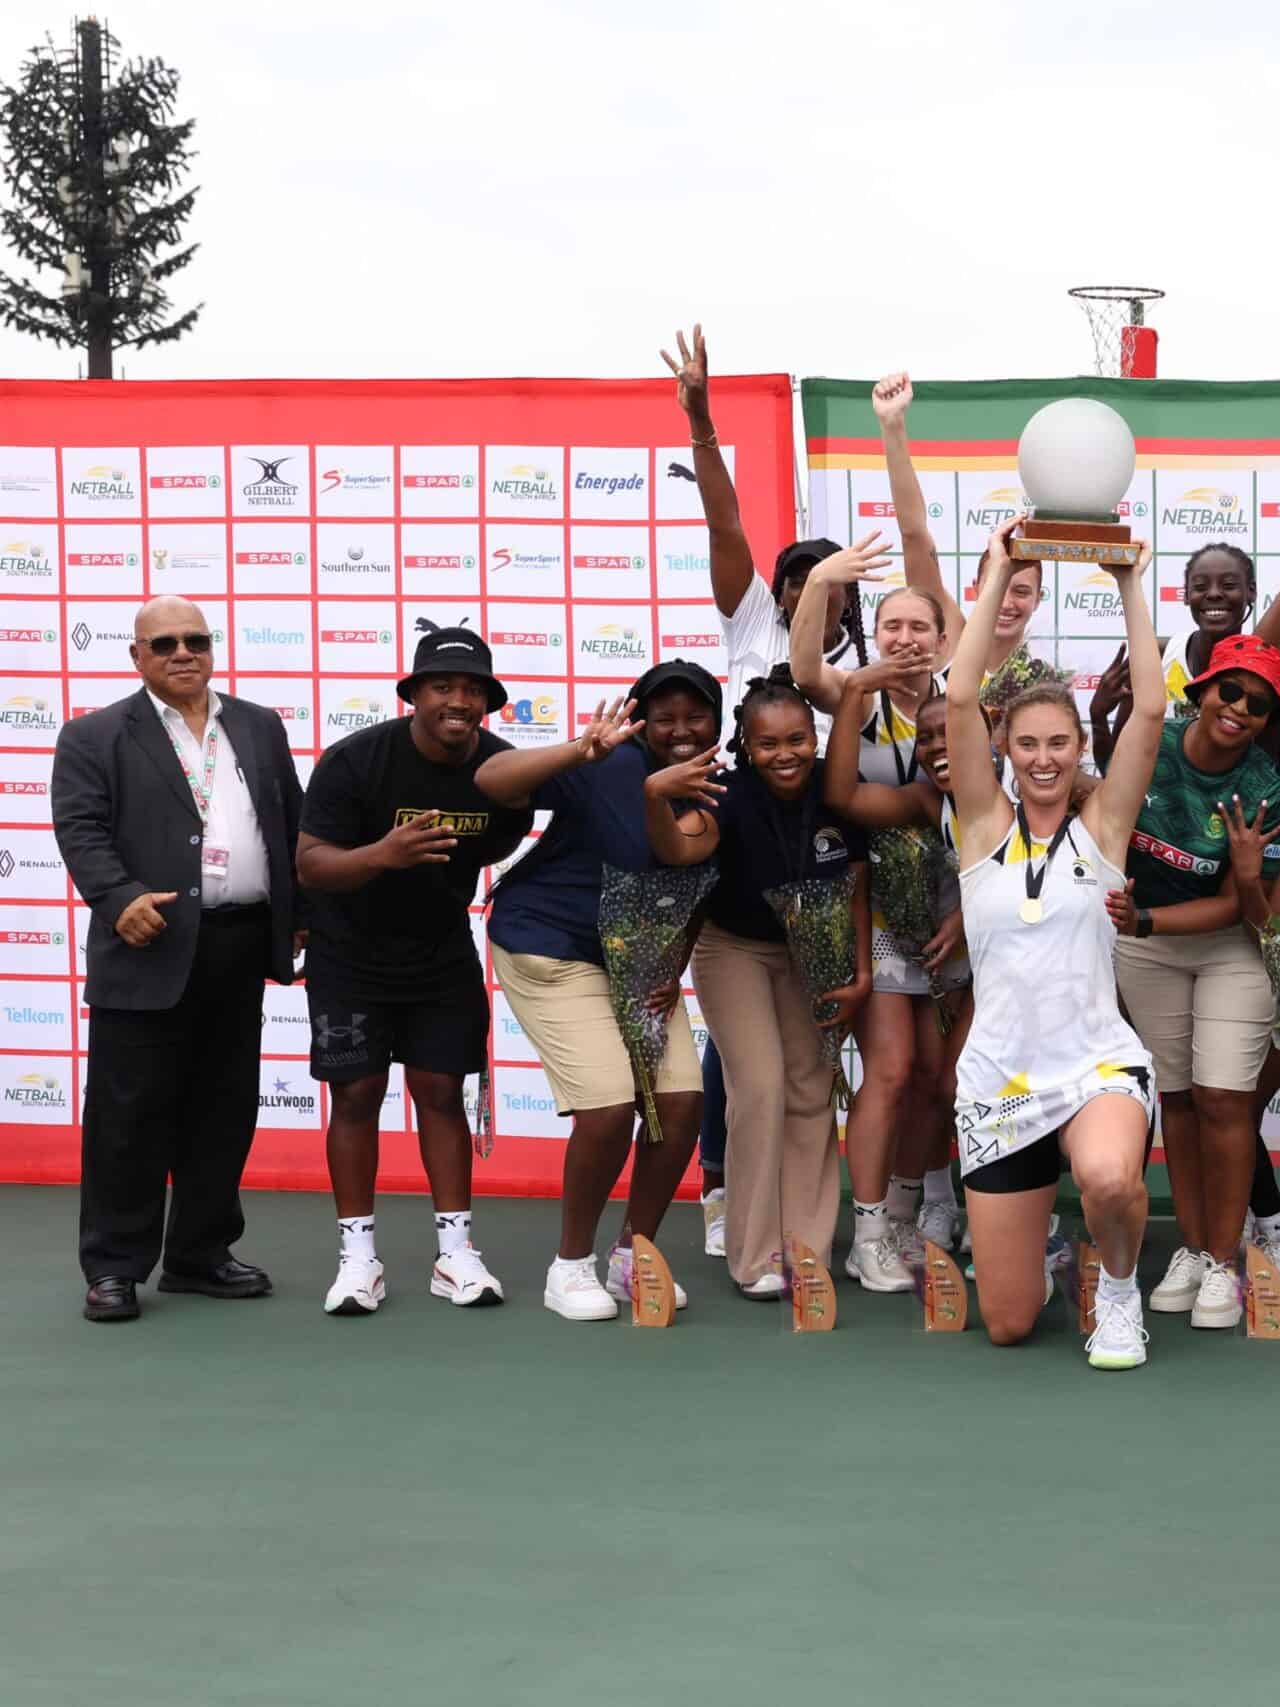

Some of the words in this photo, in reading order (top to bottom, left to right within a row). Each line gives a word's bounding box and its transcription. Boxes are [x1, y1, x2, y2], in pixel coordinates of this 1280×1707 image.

[161, 477, 206, 487] SPAR
[345, 475, 391, 484] SuperSport
[416, 477, 459, 487] SPAR
[575, 472, 644, 494] Energade
[71, 482, 134, 494] NETBALL
[243, 486, 298, 496] GILBERT
[493, 481, 556, 494] NETBALL
[247, 497, 295, 505] NETBALL
[1162, 509, 1248, 525] NETBALL
[1186, 526, 1214, 534] SOUTH
[1216, 526, 1248, 534] AFRICA
[0, 558, 52, 570] ETBALL
[80, 555, 123, 565] SPAR
[248, 554, 291, 564] SPAR
[416, 557, 460, 567] SPAR
[515, 554, 560, 564] SuperSport
[587, 557, 630, 567] SPAR
[664, 555, 711, 571] Telko
[321, 561, 368, 573] Southern
[370, 561, 391, 573] Sun
[1065, 593, 1122, 609] NETBA
[0, 631, 41, 641] SPAR
[96, 632, 136, 641] RENAUL
[243, 628, 304, 644] Telkom
[335, 632, 377, 641] SPAR
[504, 634, 546, 645] SPAR
[675, 636, 719, 646] SPAR
[581, 640, 645, 653] NETBALL
[4, 783, 47, 793] SPAR
[1136, 835, 1192, 868] SPAR
[7, 933, 49, 943] SPAR
[4, 1008, 64, 1024] Telkom
[271, 1016, 311, 1024] RENAUL
[5, 1089, 65, 1102] NETBALL
[258, 1095, 314, 1107] OLLYWOOD
